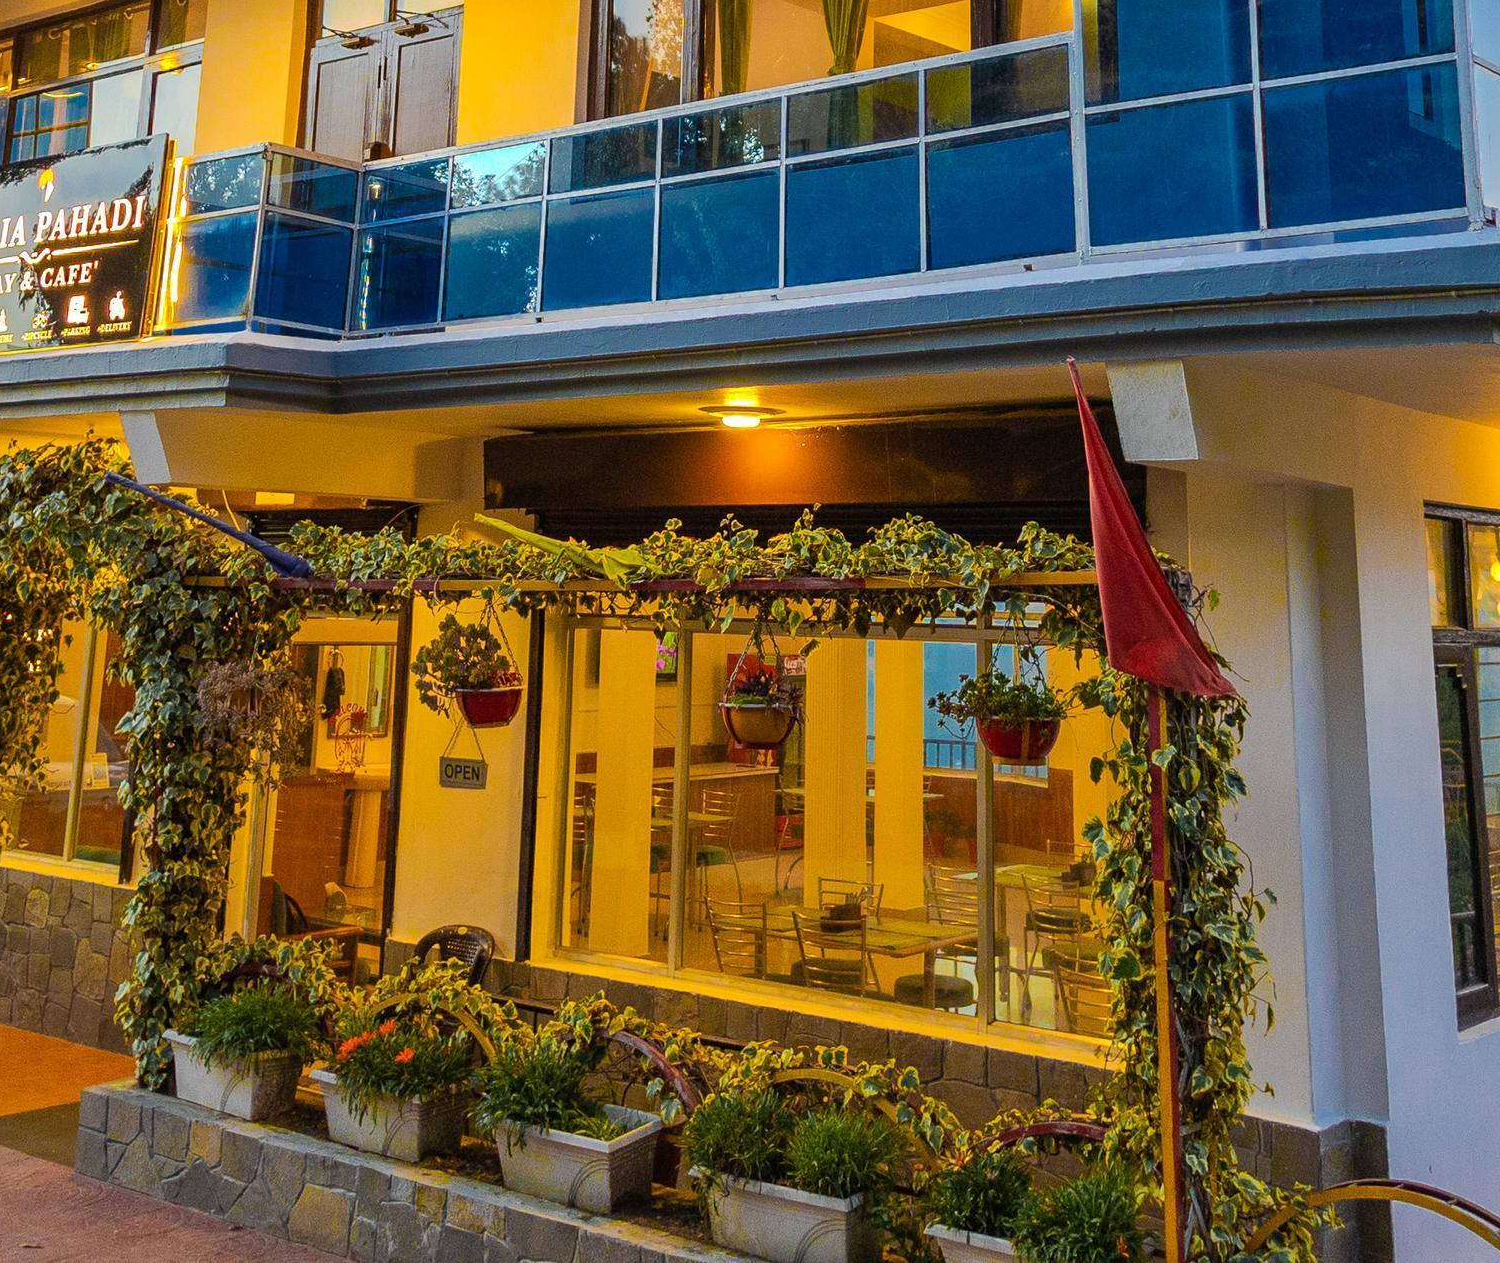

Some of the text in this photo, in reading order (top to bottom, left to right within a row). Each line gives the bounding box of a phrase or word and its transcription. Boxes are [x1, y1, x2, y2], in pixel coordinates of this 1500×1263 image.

[33, 195, 147, 244] PAHADI
[19, 271, 35, 291] &
[444, 763, 480, 781] OPEN
